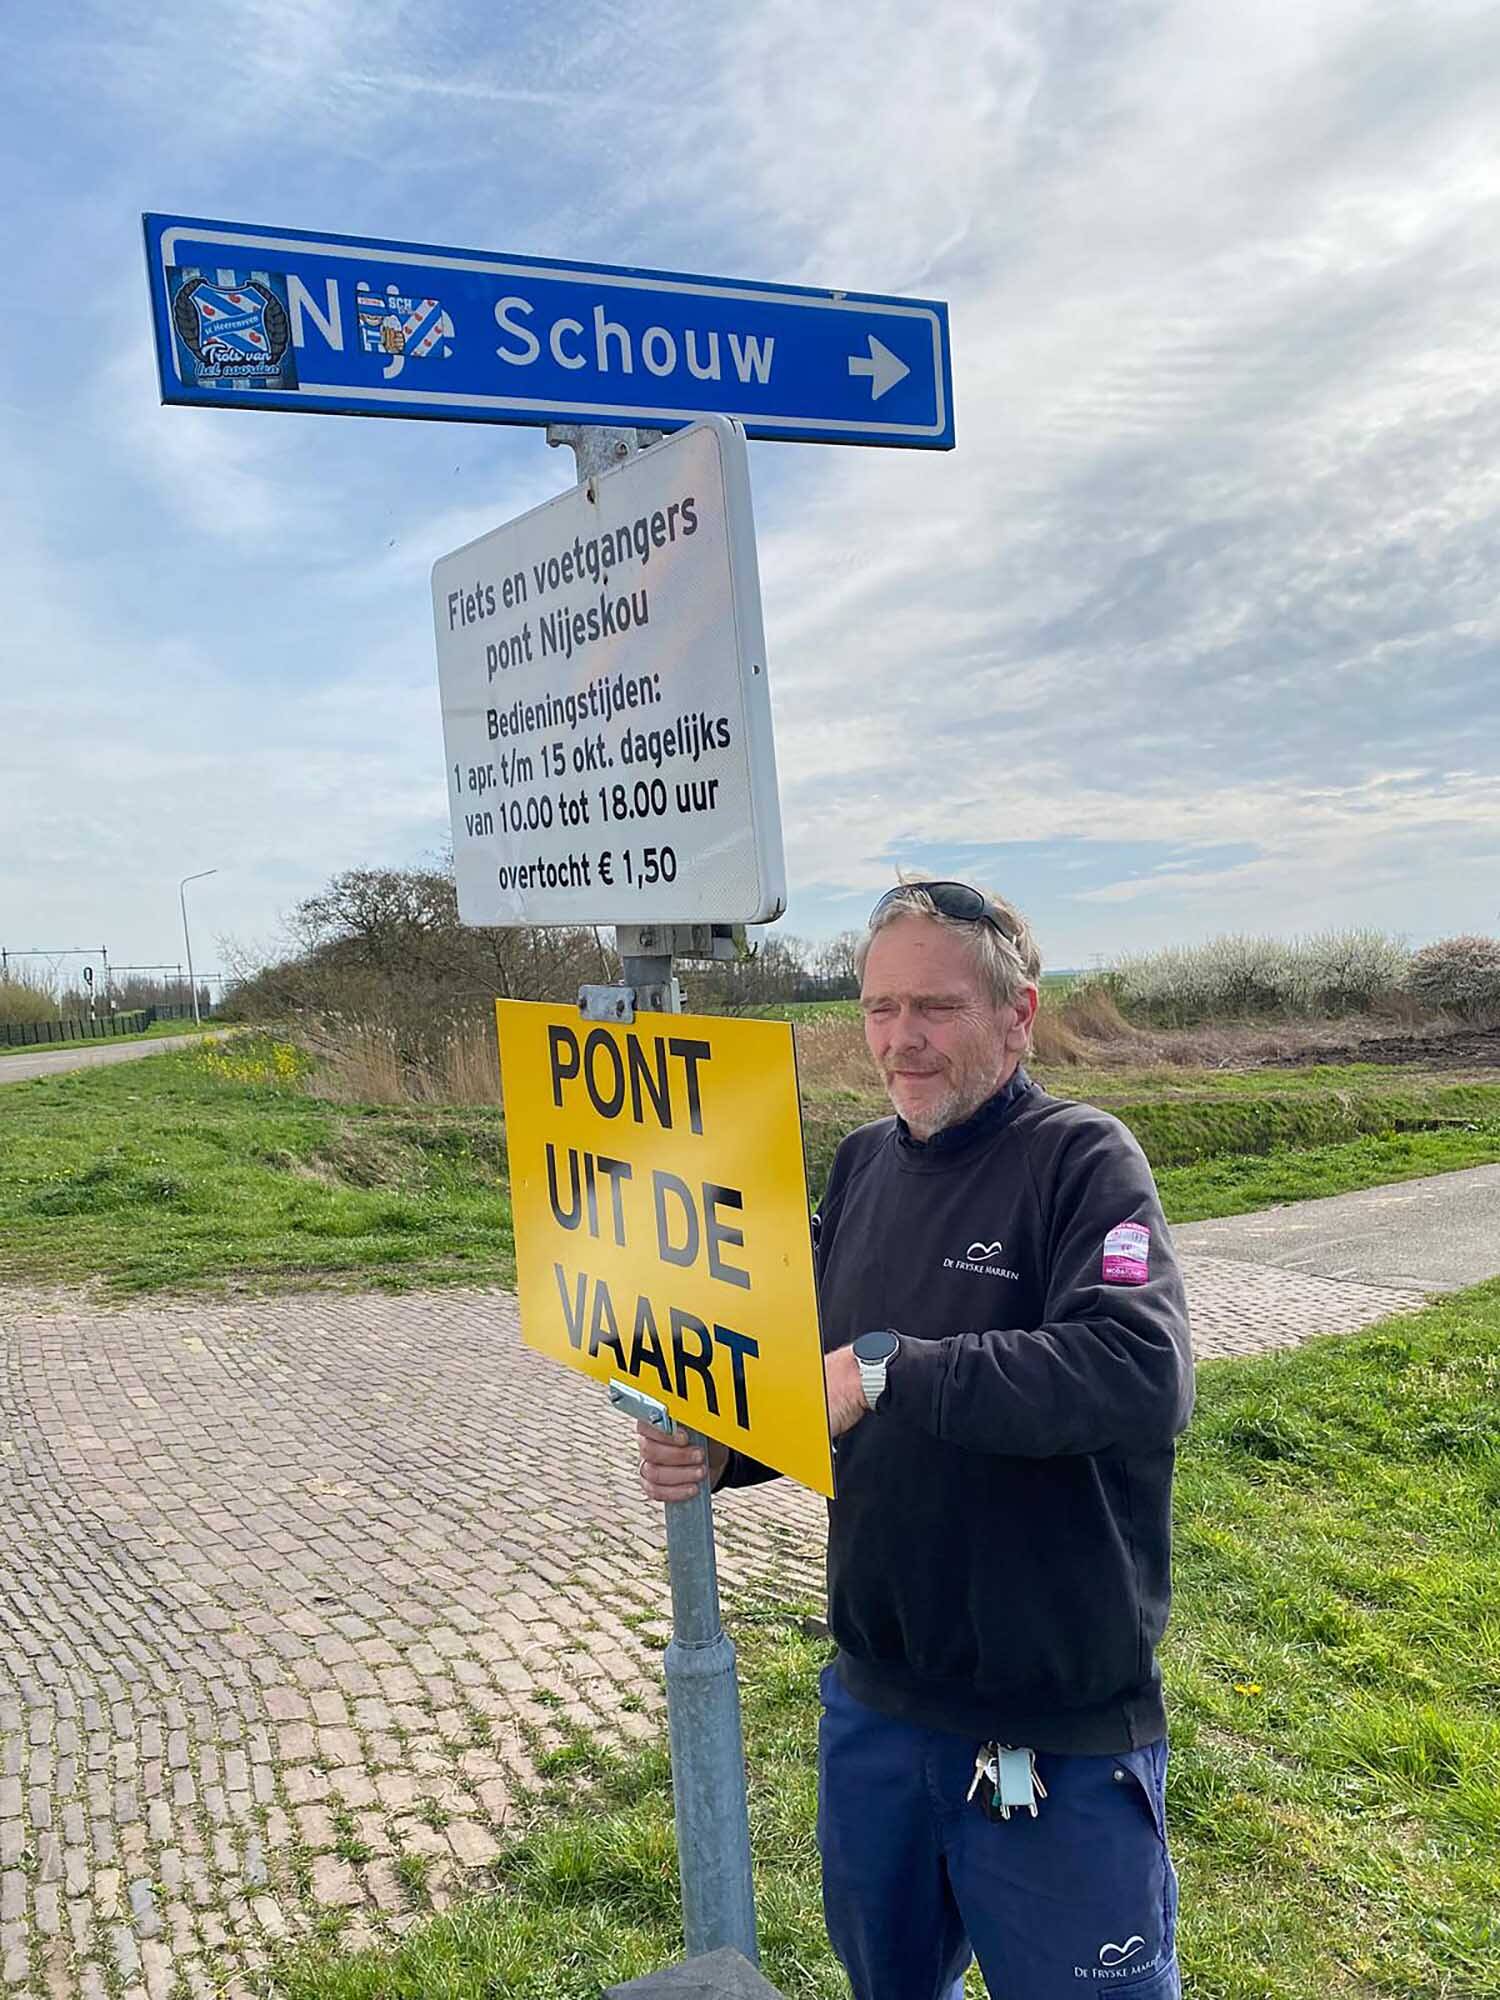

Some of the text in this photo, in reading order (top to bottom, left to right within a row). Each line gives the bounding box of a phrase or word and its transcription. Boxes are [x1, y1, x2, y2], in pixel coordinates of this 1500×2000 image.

[223, 362, 280, 377] noorden
[245, 352, 272, 361] van
[493, 296, 775, 385] Schouw
[448, 497, 699, 631] Fiets en voetgangers
[486, 588, 650, 683] pont Nijeskou
[487, 672, 662, 741] Bedieningstijden:
[454, 712, 731, 797] 1 apr. t/m 15 okt. dagelijks
[465, 778, 719, 837] van 10.00 tot 18.00 uur
[499, 846, 677, 890] overtocht € 1,50
[548, 1025, 711, 1136] PONT
[545, 1143, 751, 1290] UIT DE
[554, 1263, 759, 1431] VAART
